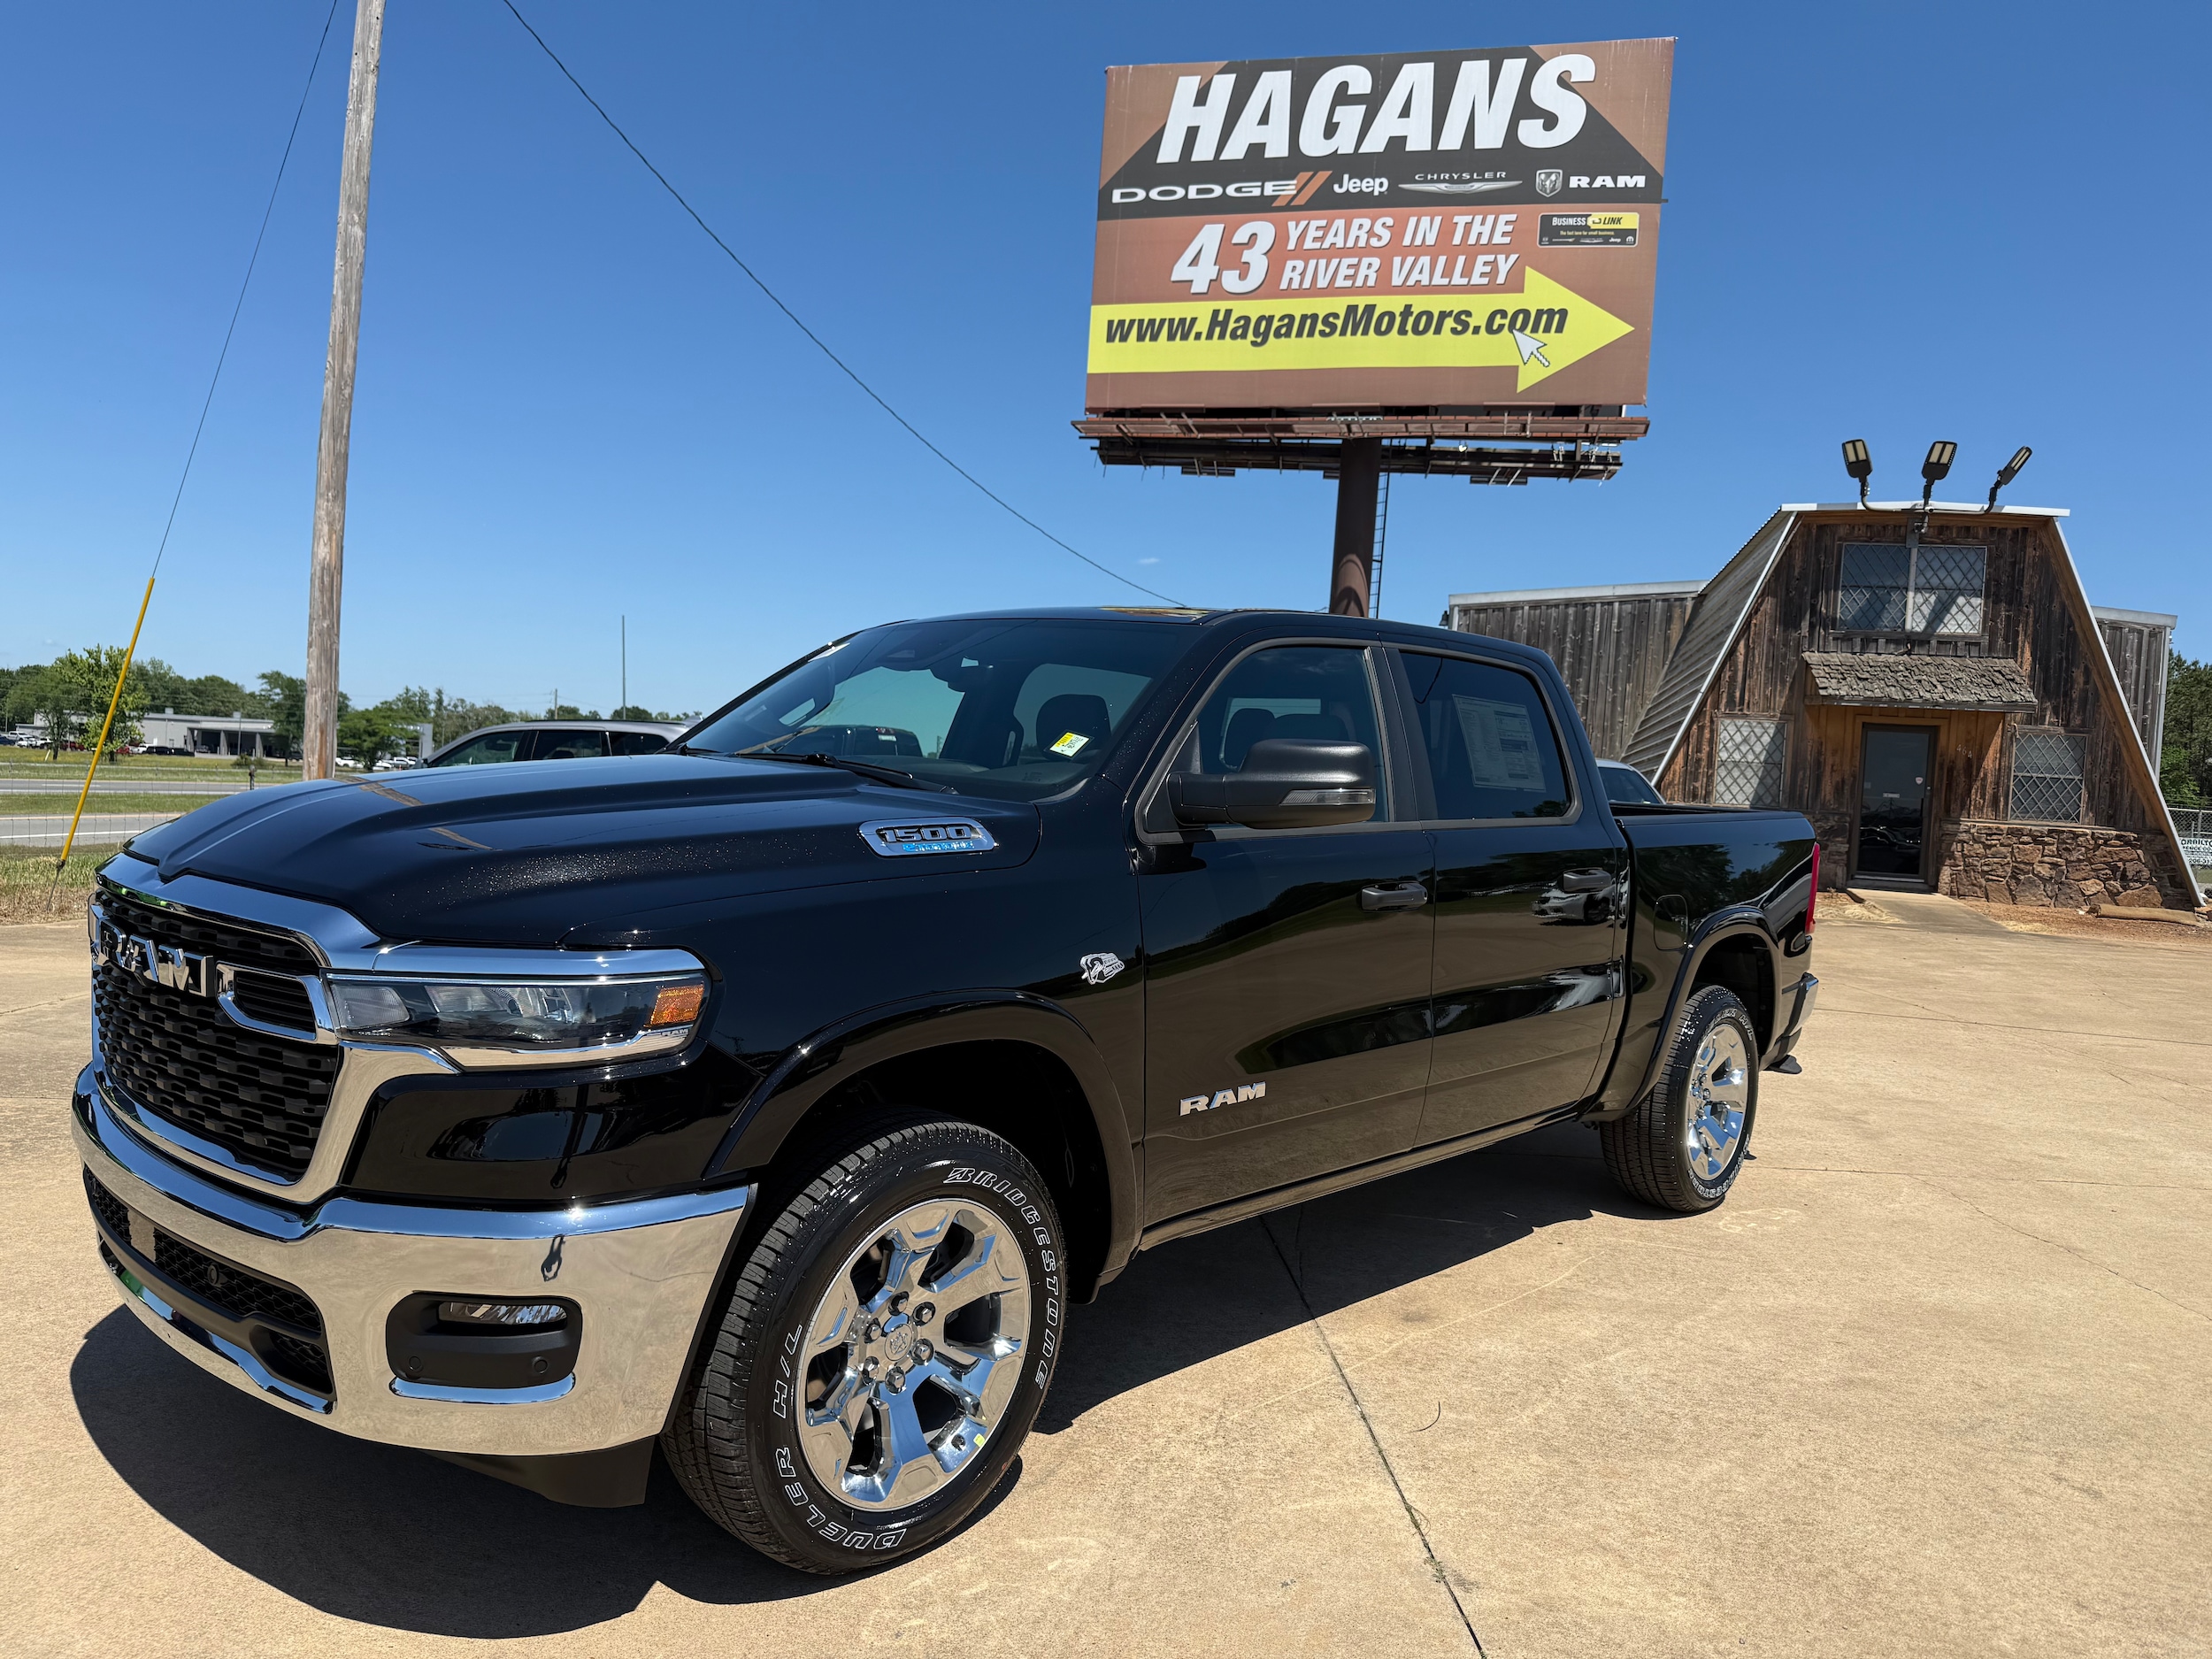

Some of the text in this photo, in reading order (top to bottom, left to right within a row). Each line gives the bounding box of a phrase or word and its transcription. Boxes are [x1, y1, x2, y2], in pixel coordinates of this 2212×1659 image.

[1156, 53, 1596, 164] HAGANS
[1111, 179, 1298, 204] DODGE
[1333, 173, 1388, 196] Jeep
[1415, 171, 1507, 180] CHRYSLER
[1569, 175, 1646, 188] RAM
[1286, 213, 1517, 251] YEARS IN THE
[1552, 217, 1623, 226] BUSINESS LINK
[1170, 219, 1277, 295] 43
[1279, 253, 1519, 290] RIVER VALLEY
[1105, 303, 1569, 348] www.HagansMotors.com
[879, 826, 972, 843] 1500
[99, 918, 214, 997] RAM
[1179, 1080, 1266, 1117] RAM
[942, 1166, 1059, 1391] BRIDGESTONE
[772, 1324, 803, 1419] H/L
[773, 1446, 907, 1550] DUELER
